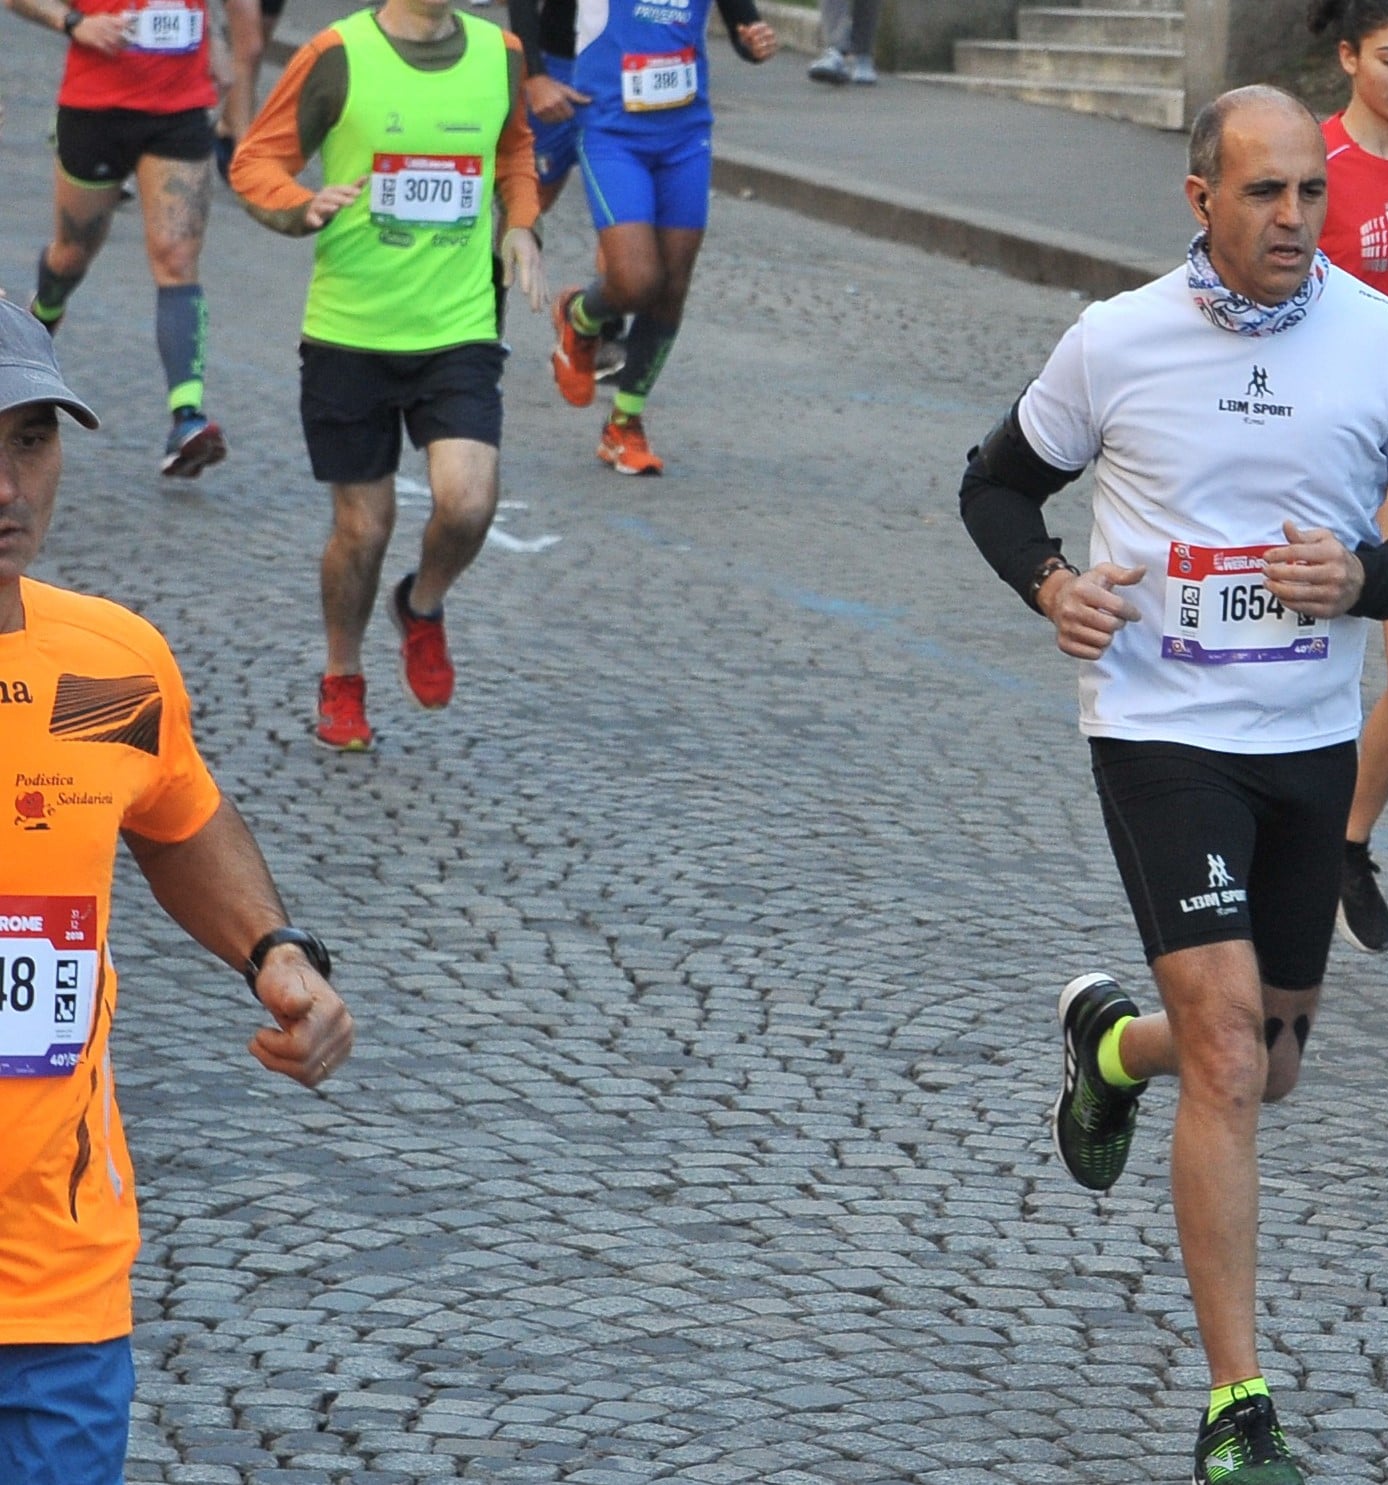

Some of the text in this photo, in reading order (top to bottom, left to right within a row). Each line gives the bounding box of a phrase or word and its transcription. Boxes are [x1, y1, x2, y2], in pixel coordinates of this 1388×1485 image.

[405, 178, 453, 203] 3070
[1218, 398, 1295, 418] LBM SPORT
[1219, 584, 1286, 622] 1654
[15, 773, 74, 787] Podistica
[1179, 892, 1221, 913] LBM
